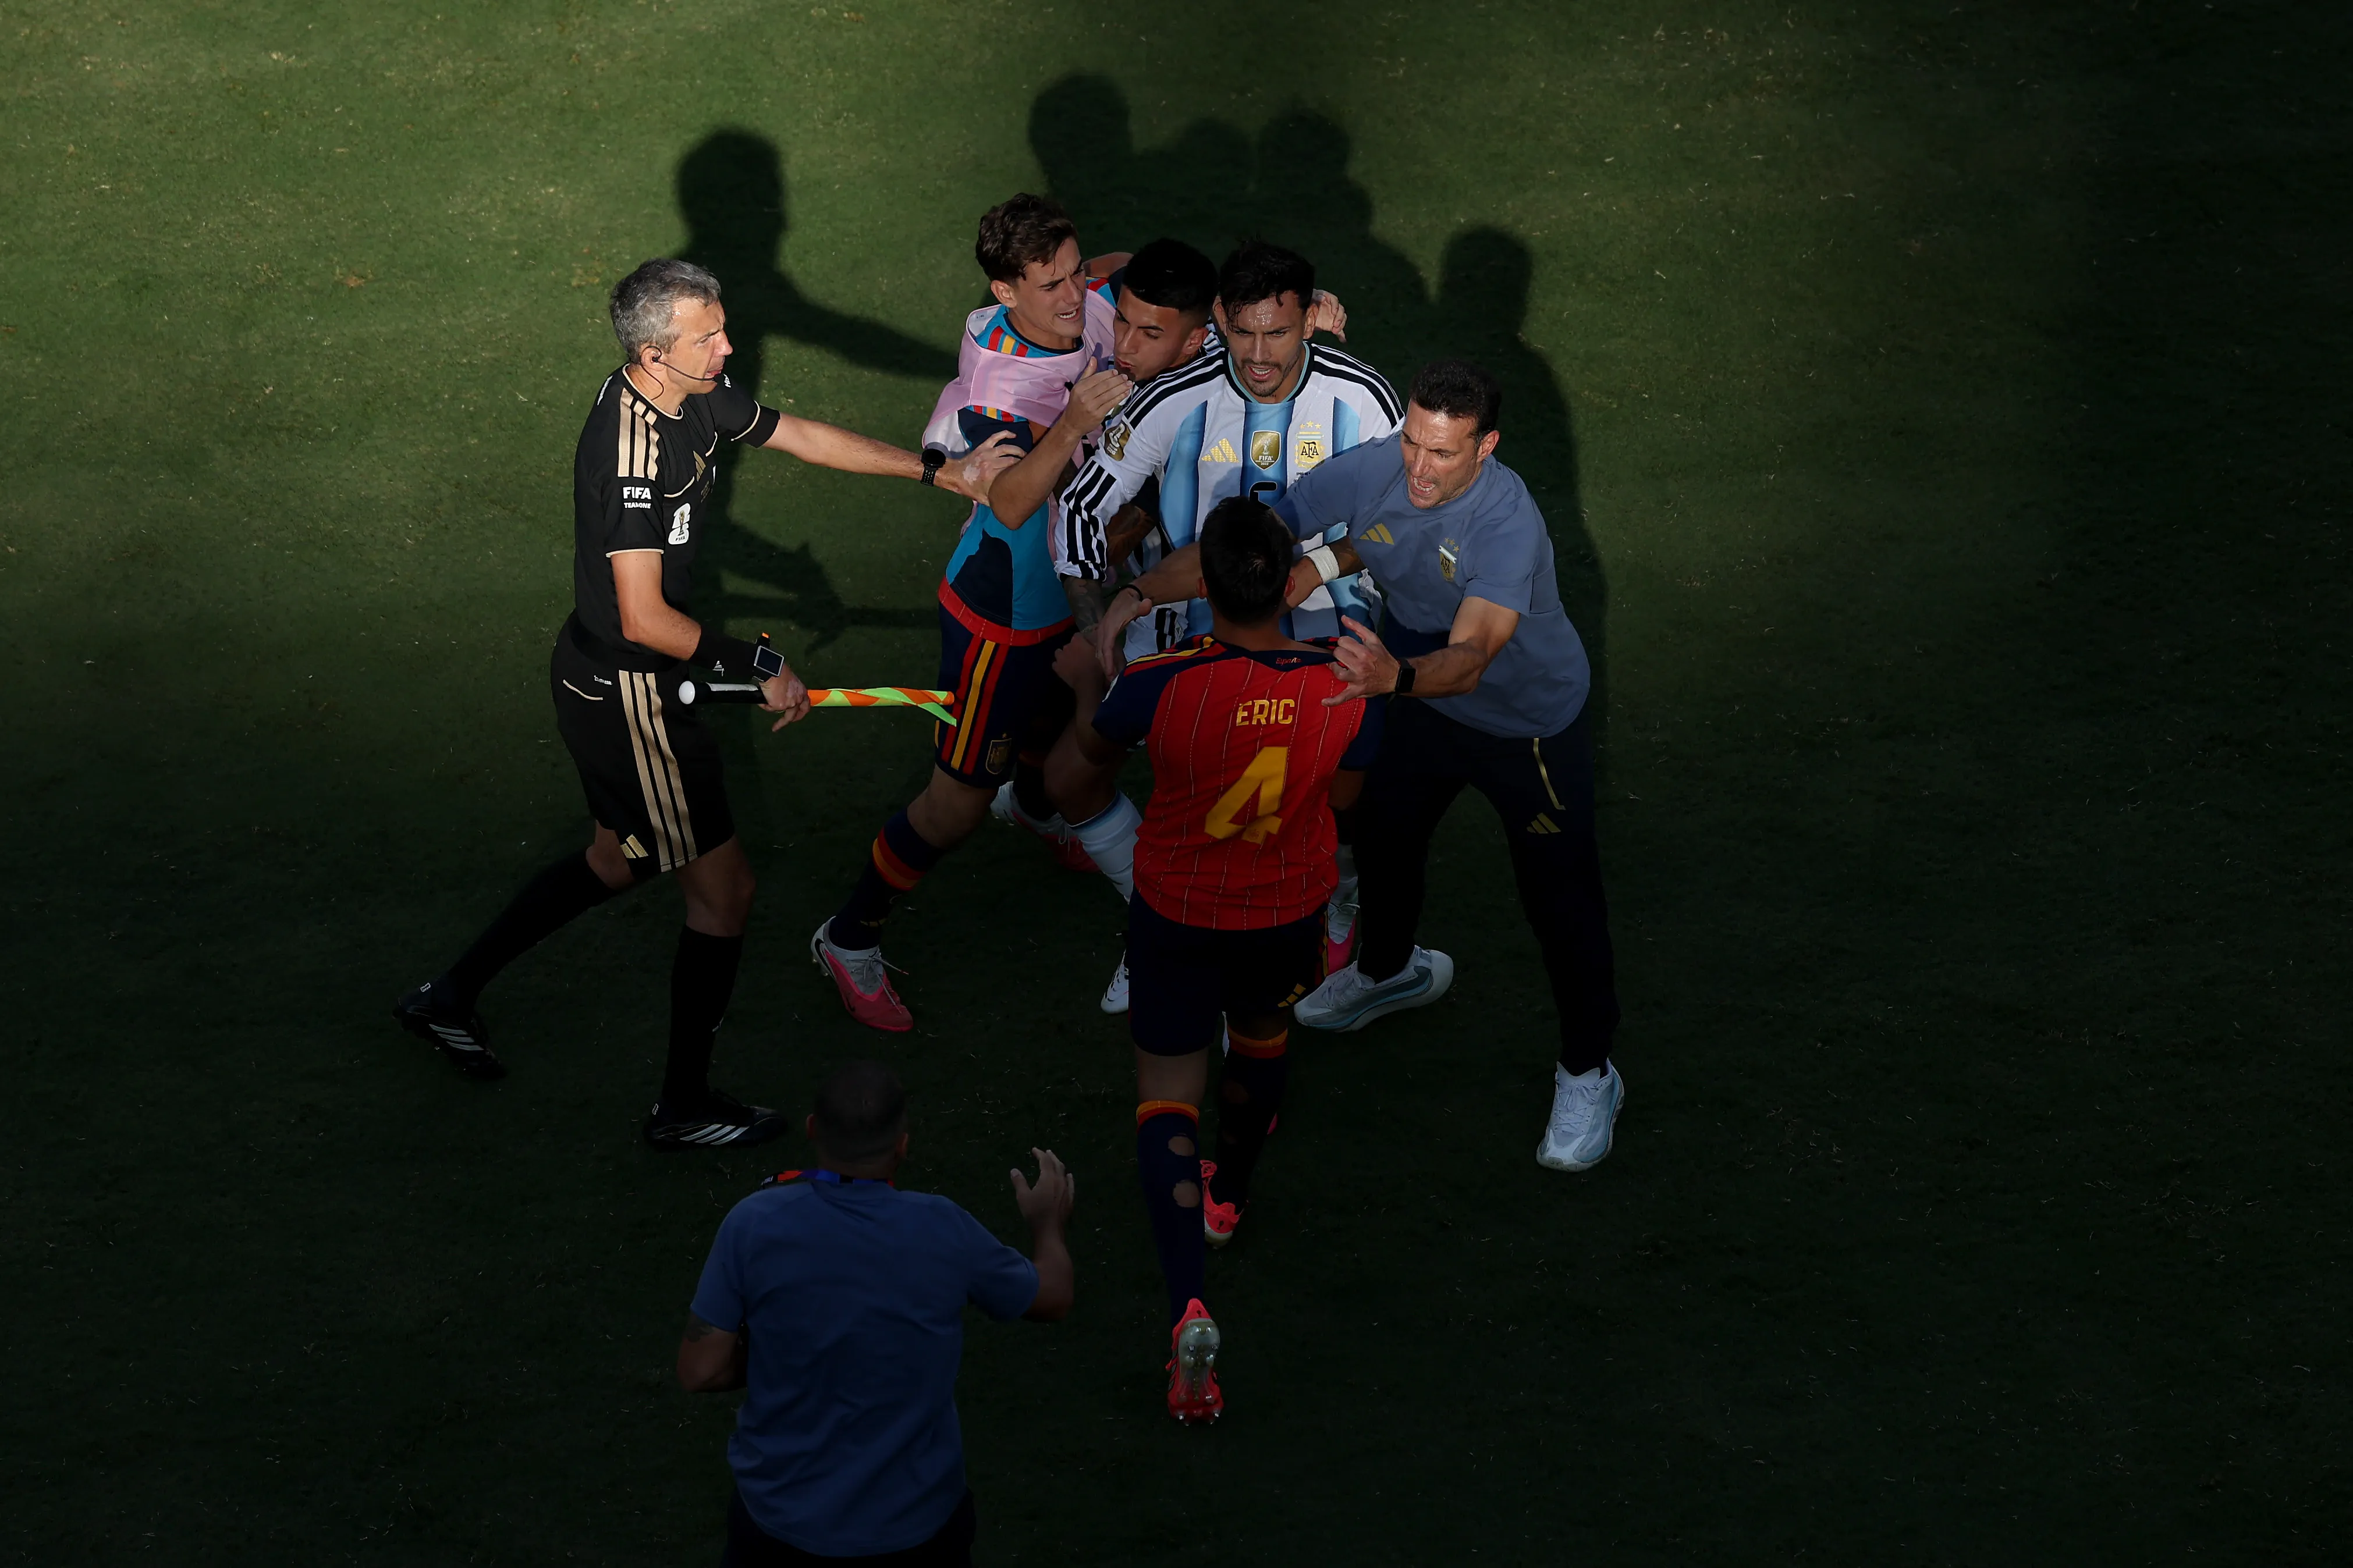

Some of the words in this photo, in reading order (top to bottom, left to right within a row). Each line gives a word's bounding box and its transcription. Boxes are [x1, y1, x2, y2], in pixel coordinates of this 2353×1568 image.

[1301, 441, 1319, 458] AFA
[623, 486, 651, 499] FIFA
[1236, 699, 1296, 727] ERIC
[1203, 746, 1289, 844] 4
